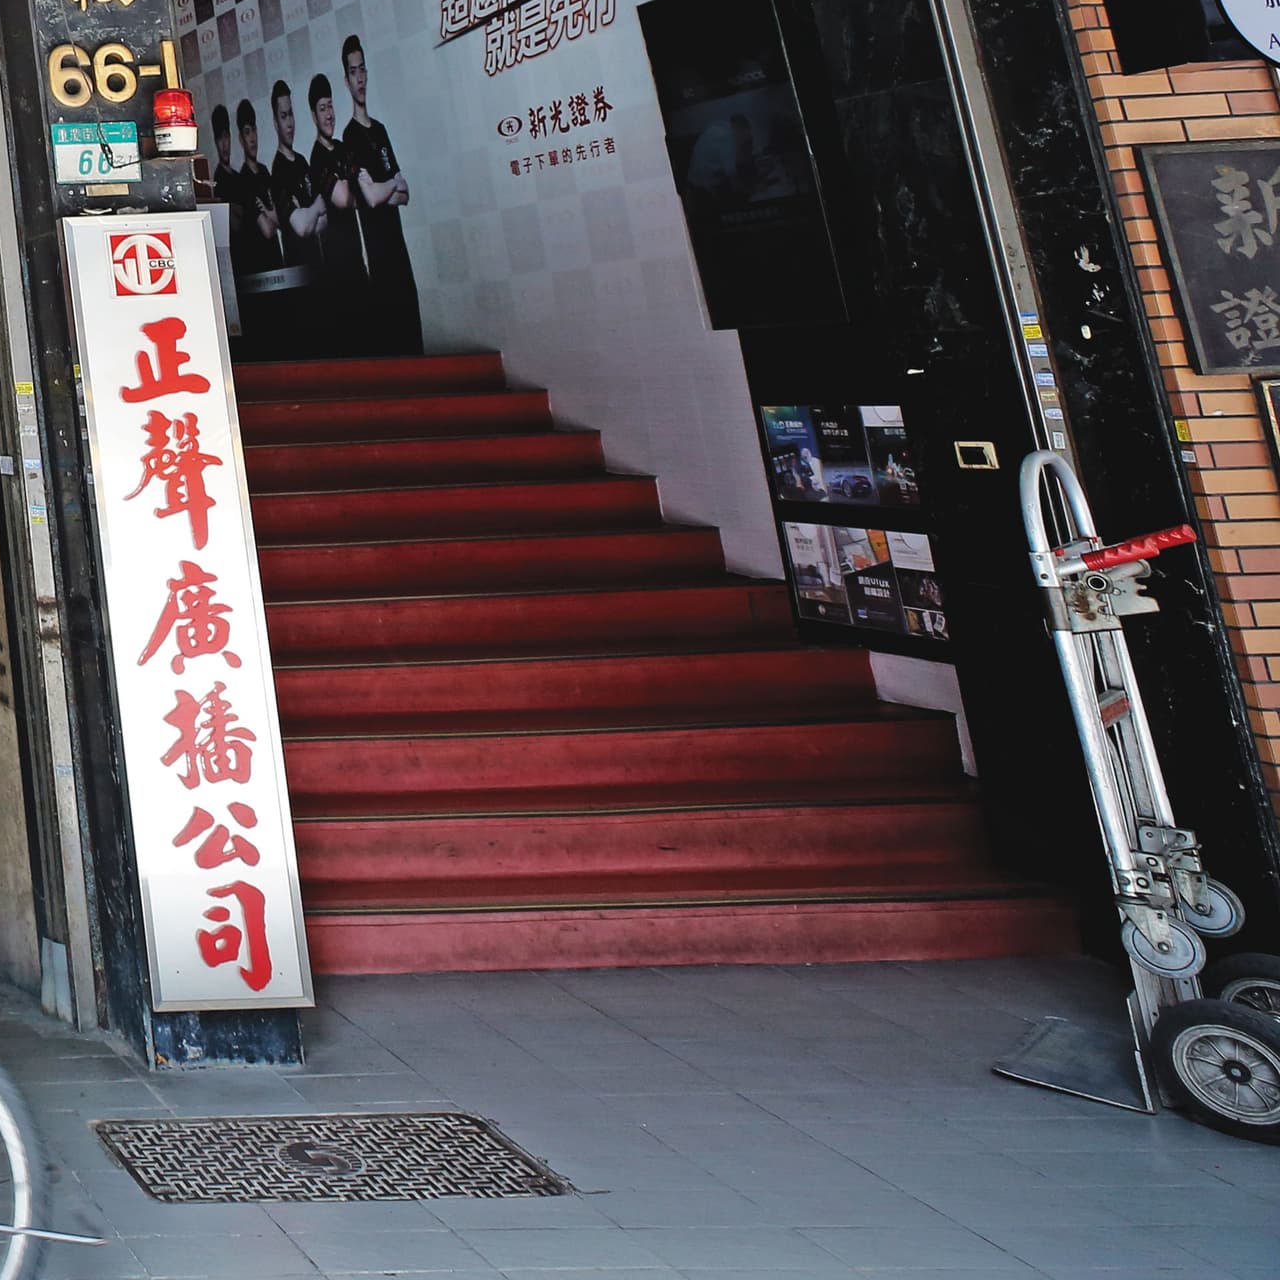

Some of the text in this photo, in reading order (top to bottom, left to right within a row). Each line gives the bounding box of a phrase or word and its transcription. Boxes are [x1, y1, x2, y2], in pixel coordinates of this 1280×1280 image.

[528, 85, 614, 140] 新光證券
[119, 317, 271, 993] 正聲廣播公司
